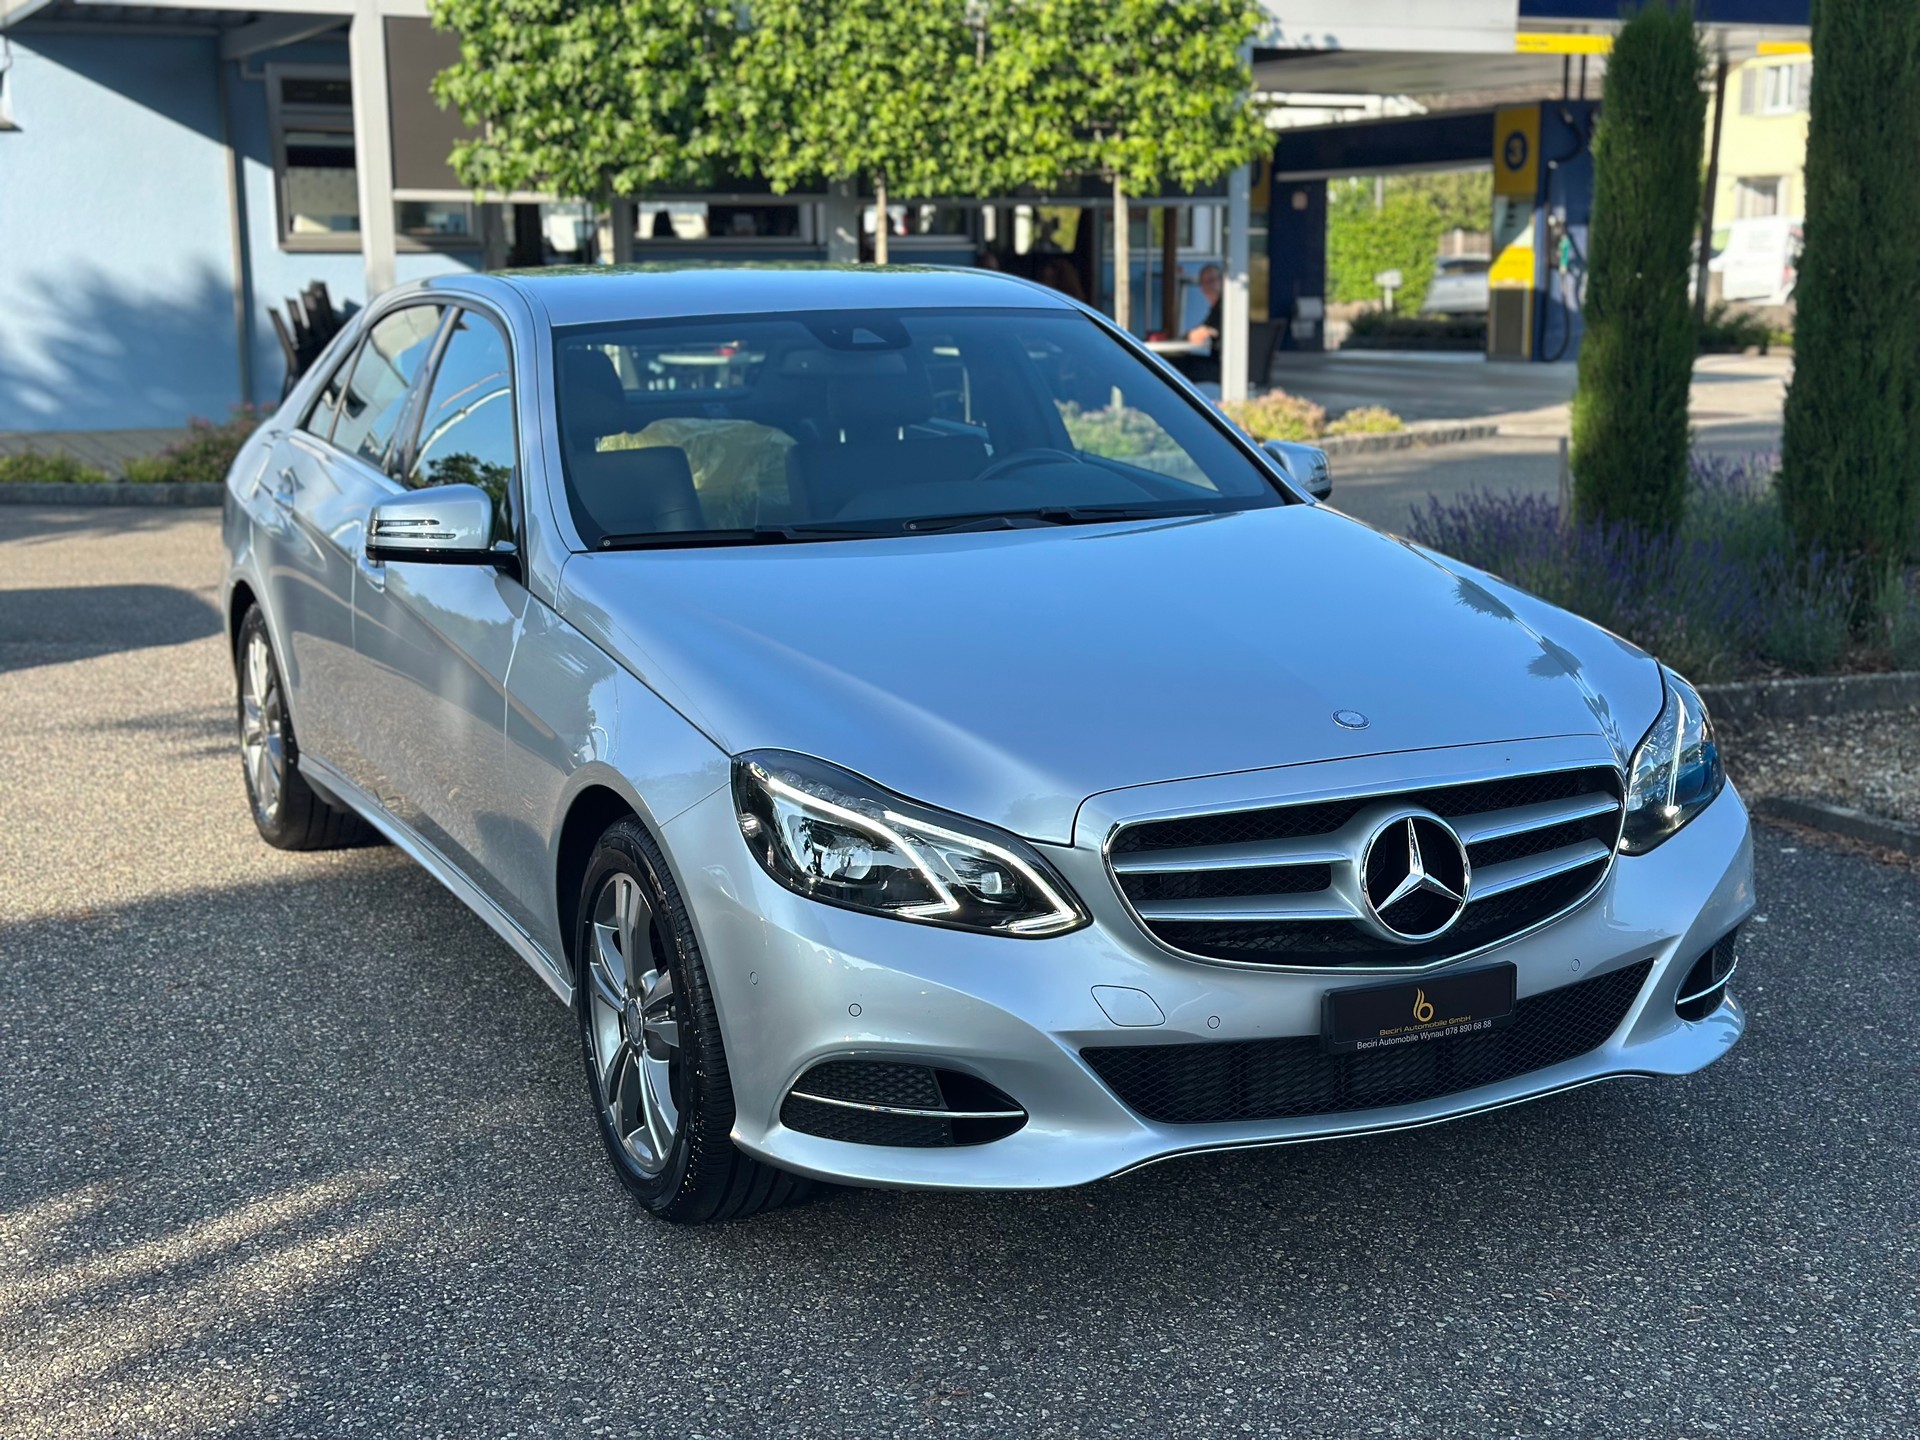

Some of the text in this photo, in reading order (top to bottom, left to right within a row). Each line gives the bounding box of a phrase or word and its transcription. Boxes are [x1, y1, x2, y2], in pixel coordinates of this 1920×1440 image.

[1356, 1019, 1492, 1050] Beciri Automobile Wynau 078 890 68 88
[1379, 1015, 1472, 1036] Beciri Automobile GmbH
